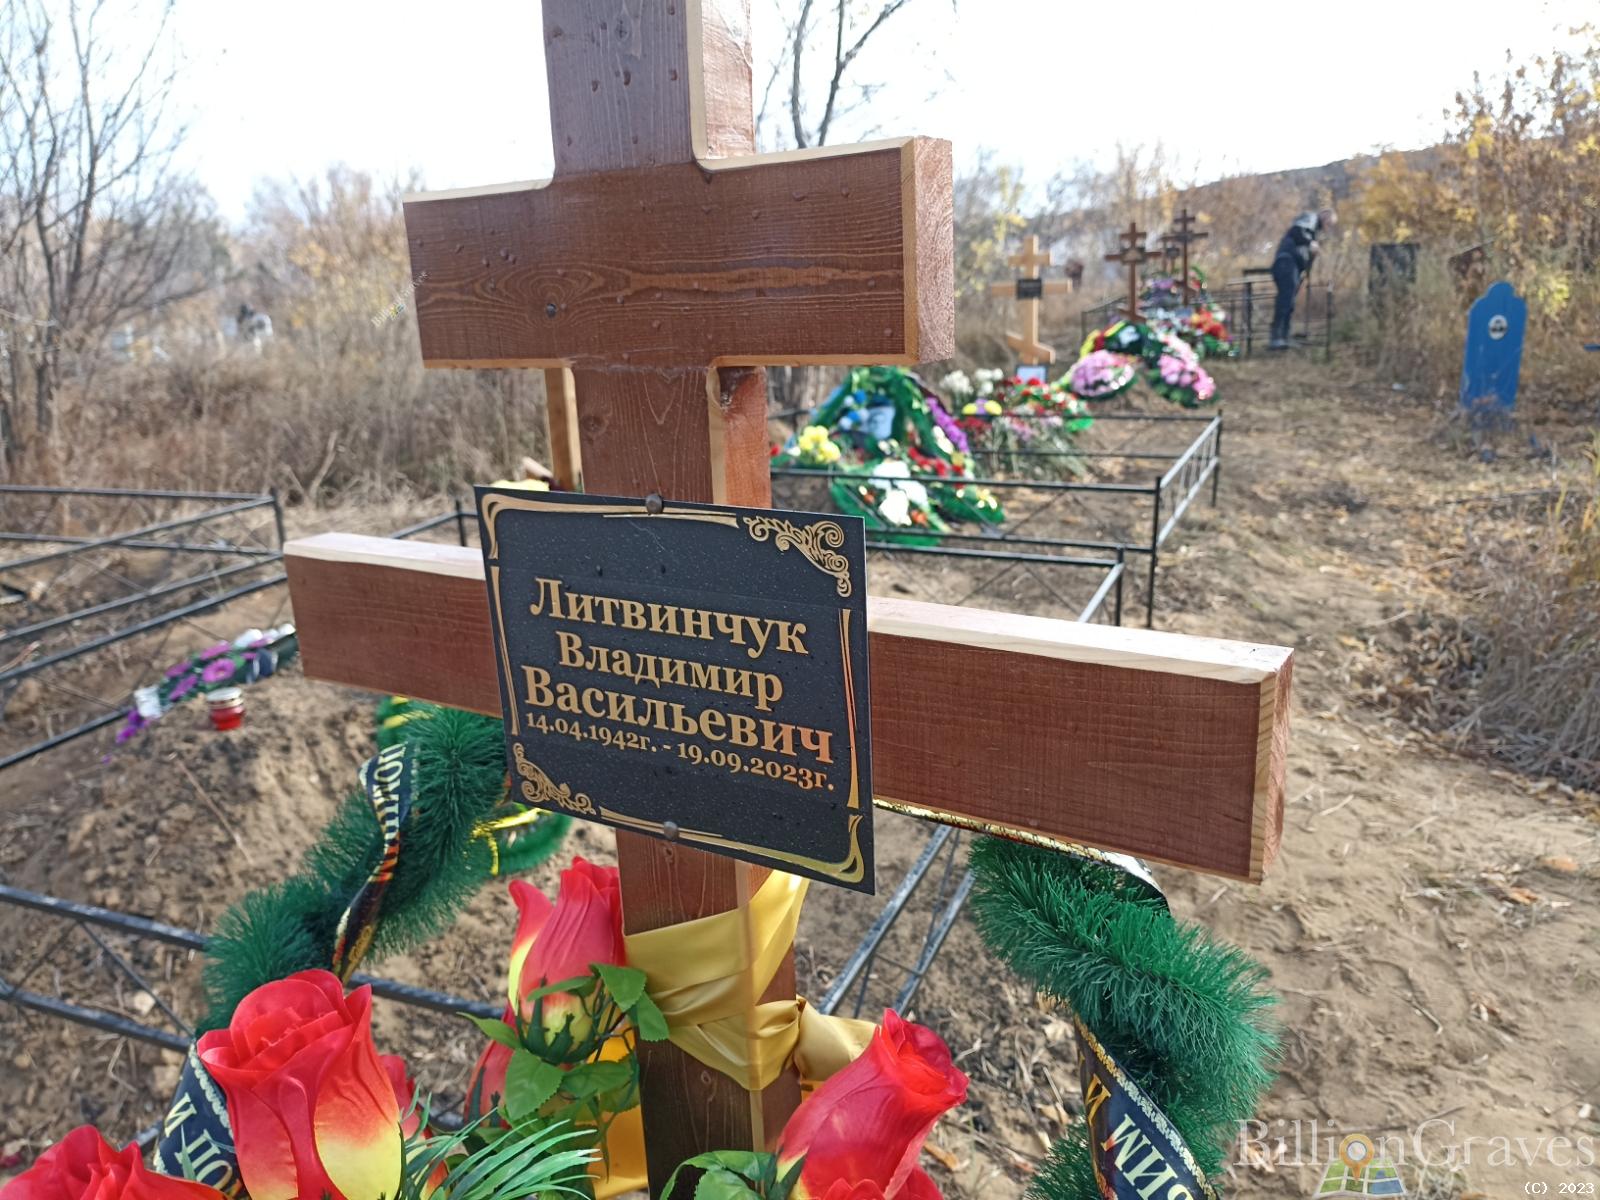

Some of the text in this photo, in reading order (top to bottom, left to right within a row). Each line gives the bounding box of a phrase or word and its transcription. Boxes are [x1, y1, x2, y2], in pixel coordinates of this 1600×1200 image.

[529, 577, 809, 659] Литвинчук
[555, 630, 784, 712] Владимир
[520, 664, 835, 765] Васильевич
[526, 712, 657, 752] 14.04.1942г.
[677, 742, 835, 791] 19.09.2023г.
